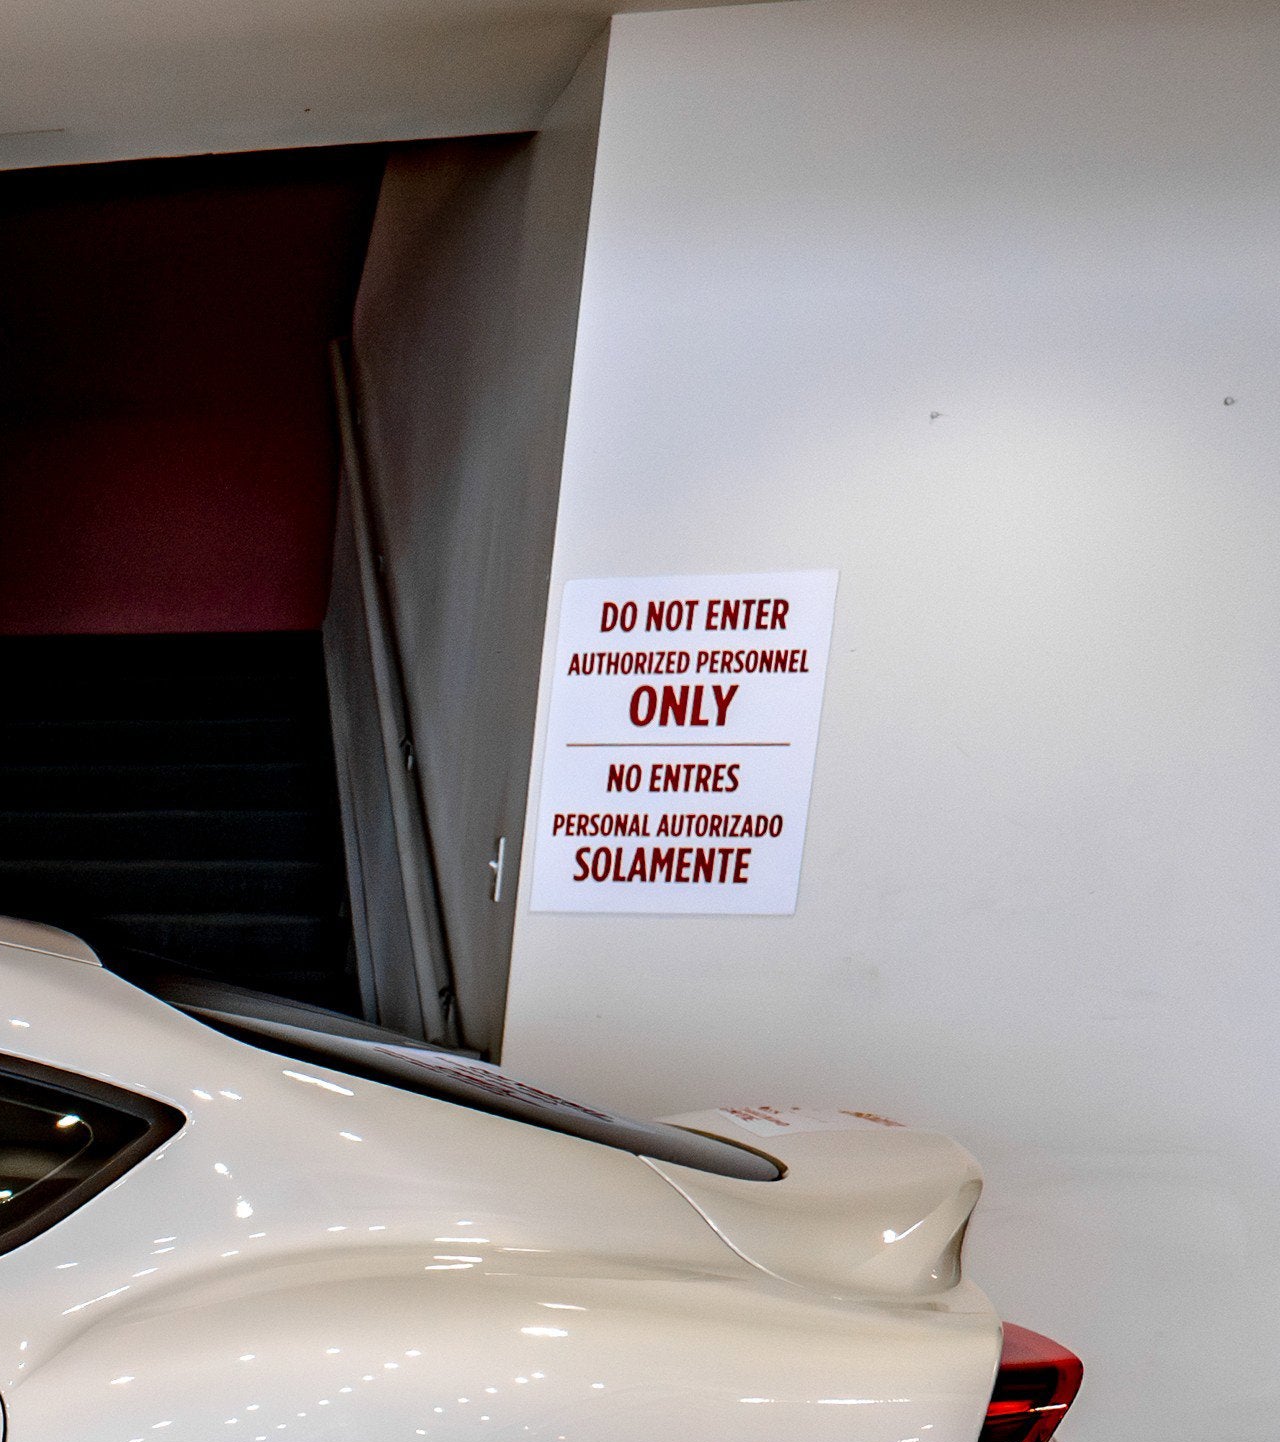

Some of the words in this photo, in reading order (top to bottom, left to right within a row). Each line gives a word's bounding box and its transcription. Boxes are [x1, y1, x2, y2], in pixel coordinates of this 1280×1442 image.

[600, 600, 638, 633] DO
[645, 599, 699, 632] NOT
[705, 598, 789, 631] ENTER
[568, 652, 690, 676] AUTHORIZED
[696, 649, 809, 674] PERSONNEL
[629, 684, 740, 727] ONLY
[606, 763, 642, 792] NO
[648, 763, 741, 793] ENTRES
[552, 813, 651, 837] PERSONAL
[656, 814, 784, 838] AUTORIZADO
[573, 847, 752, 884] SOLAMENTE
